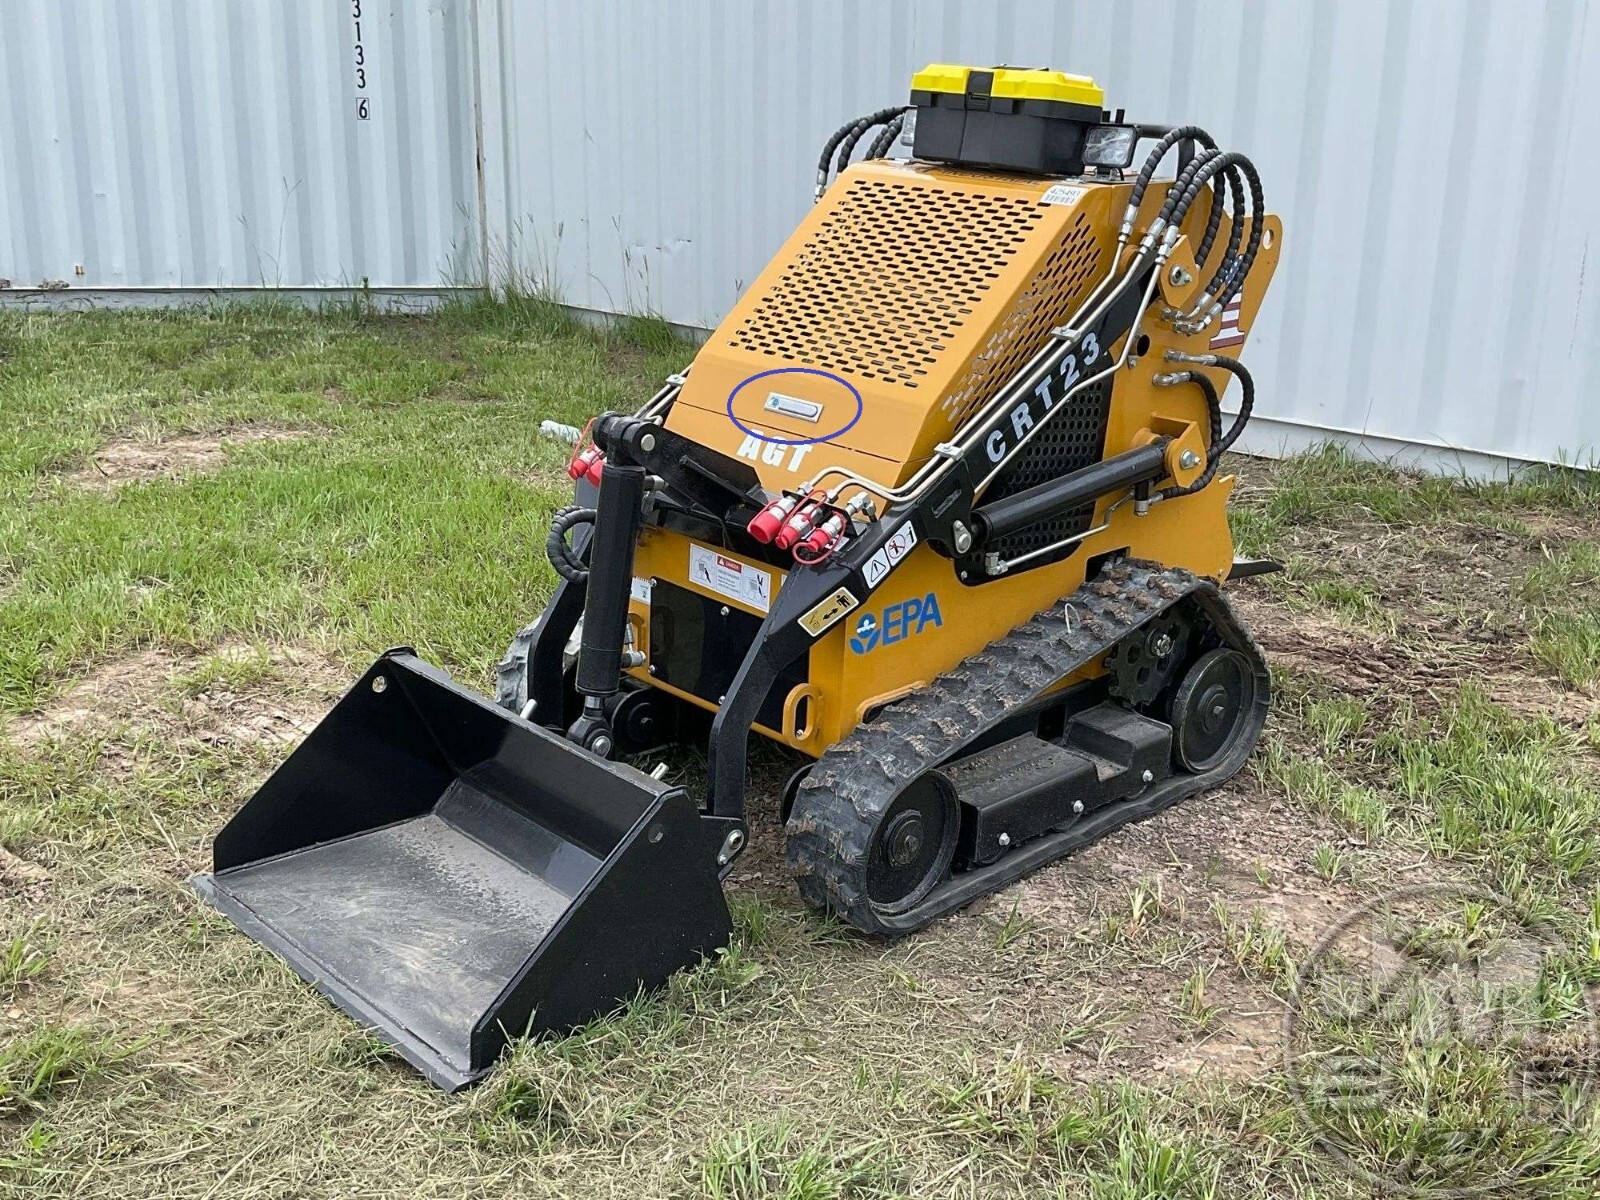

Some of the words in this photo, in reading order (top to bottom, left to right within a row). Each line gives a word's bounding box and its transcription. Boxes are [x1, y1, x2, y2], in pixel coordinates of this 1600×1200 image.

[358, 99, 368, 119] 6
[986, 332, 1100, 463] CRT23
[736, 428, 813, 473] AGT
[881, 592, 943, 646] EPA
